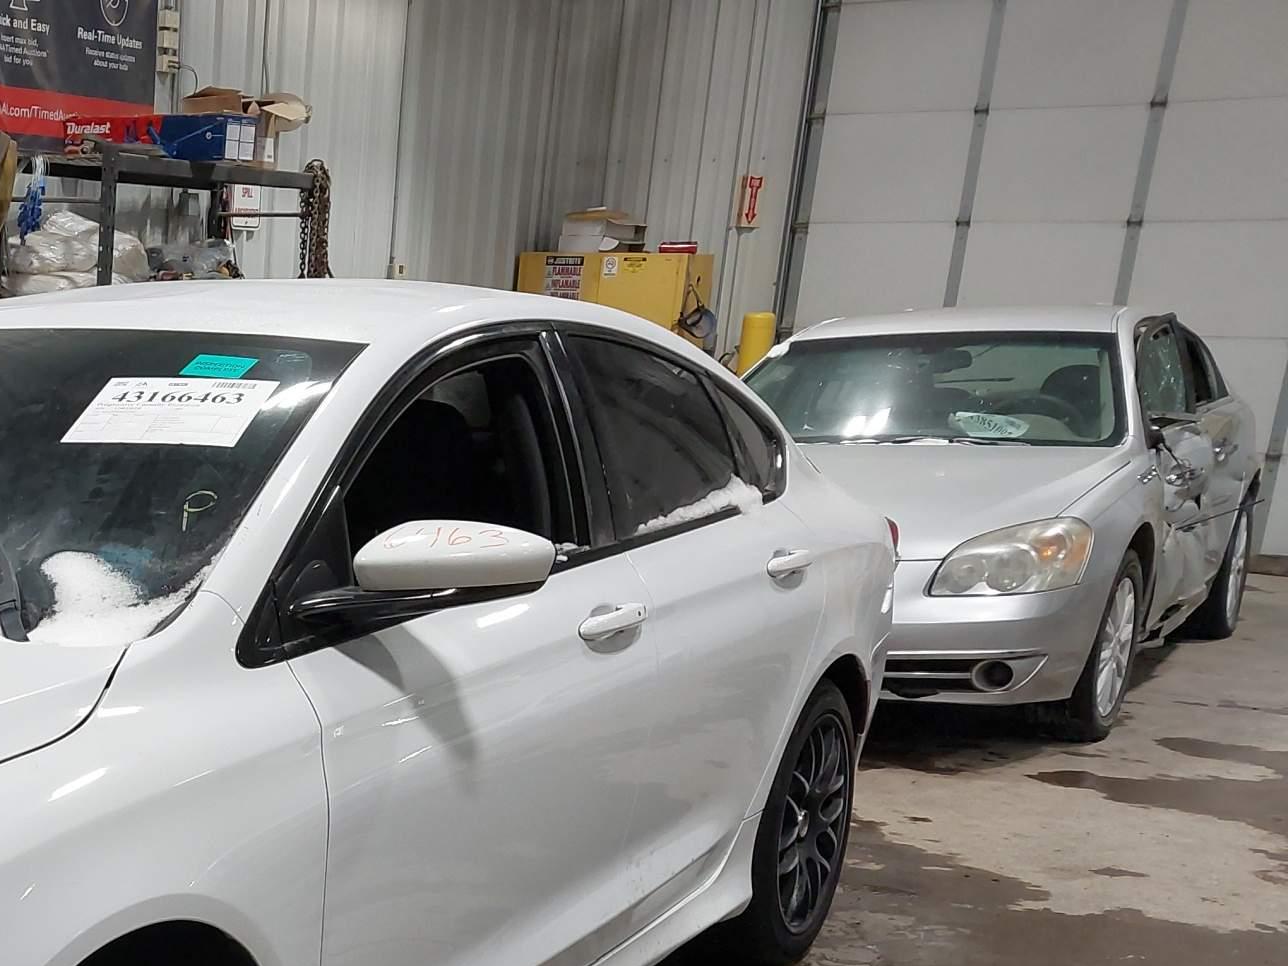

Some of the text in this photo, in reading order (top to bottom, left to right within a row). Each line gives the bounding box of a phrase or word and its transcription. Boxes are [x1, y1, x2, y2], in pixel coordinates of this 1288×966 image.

[12, 18, 28, 30] and
[30, 18, 50, 36] Easy
[77, 26, 143, 50] Real-Time Updates
[65, 121, 112, 136] Duralast
[112, 390, 246, 405] 43166463
